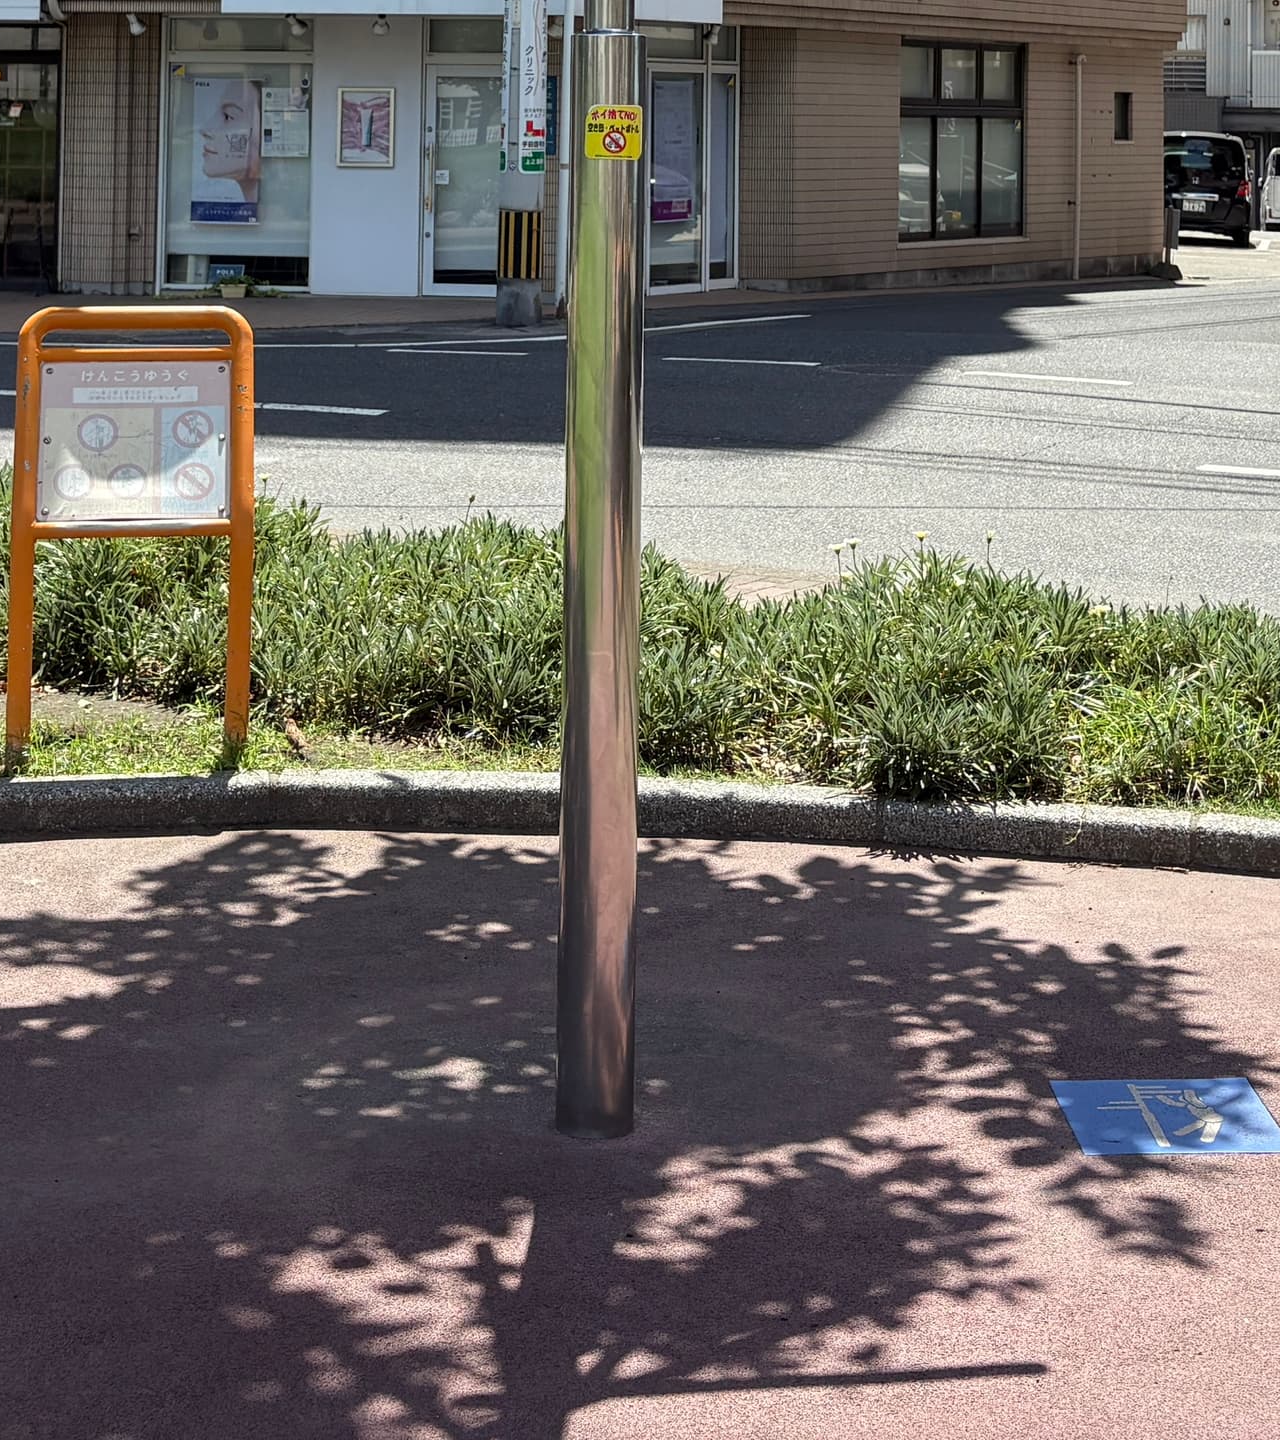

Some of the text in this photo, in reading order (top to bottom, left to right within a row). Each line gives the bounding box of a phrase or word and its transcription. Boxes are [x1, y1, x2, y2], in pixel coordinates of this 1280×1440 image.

[524, 45, 535, 96] クリニック
[81, 369, 190, 383] けんこうゆうぐ
